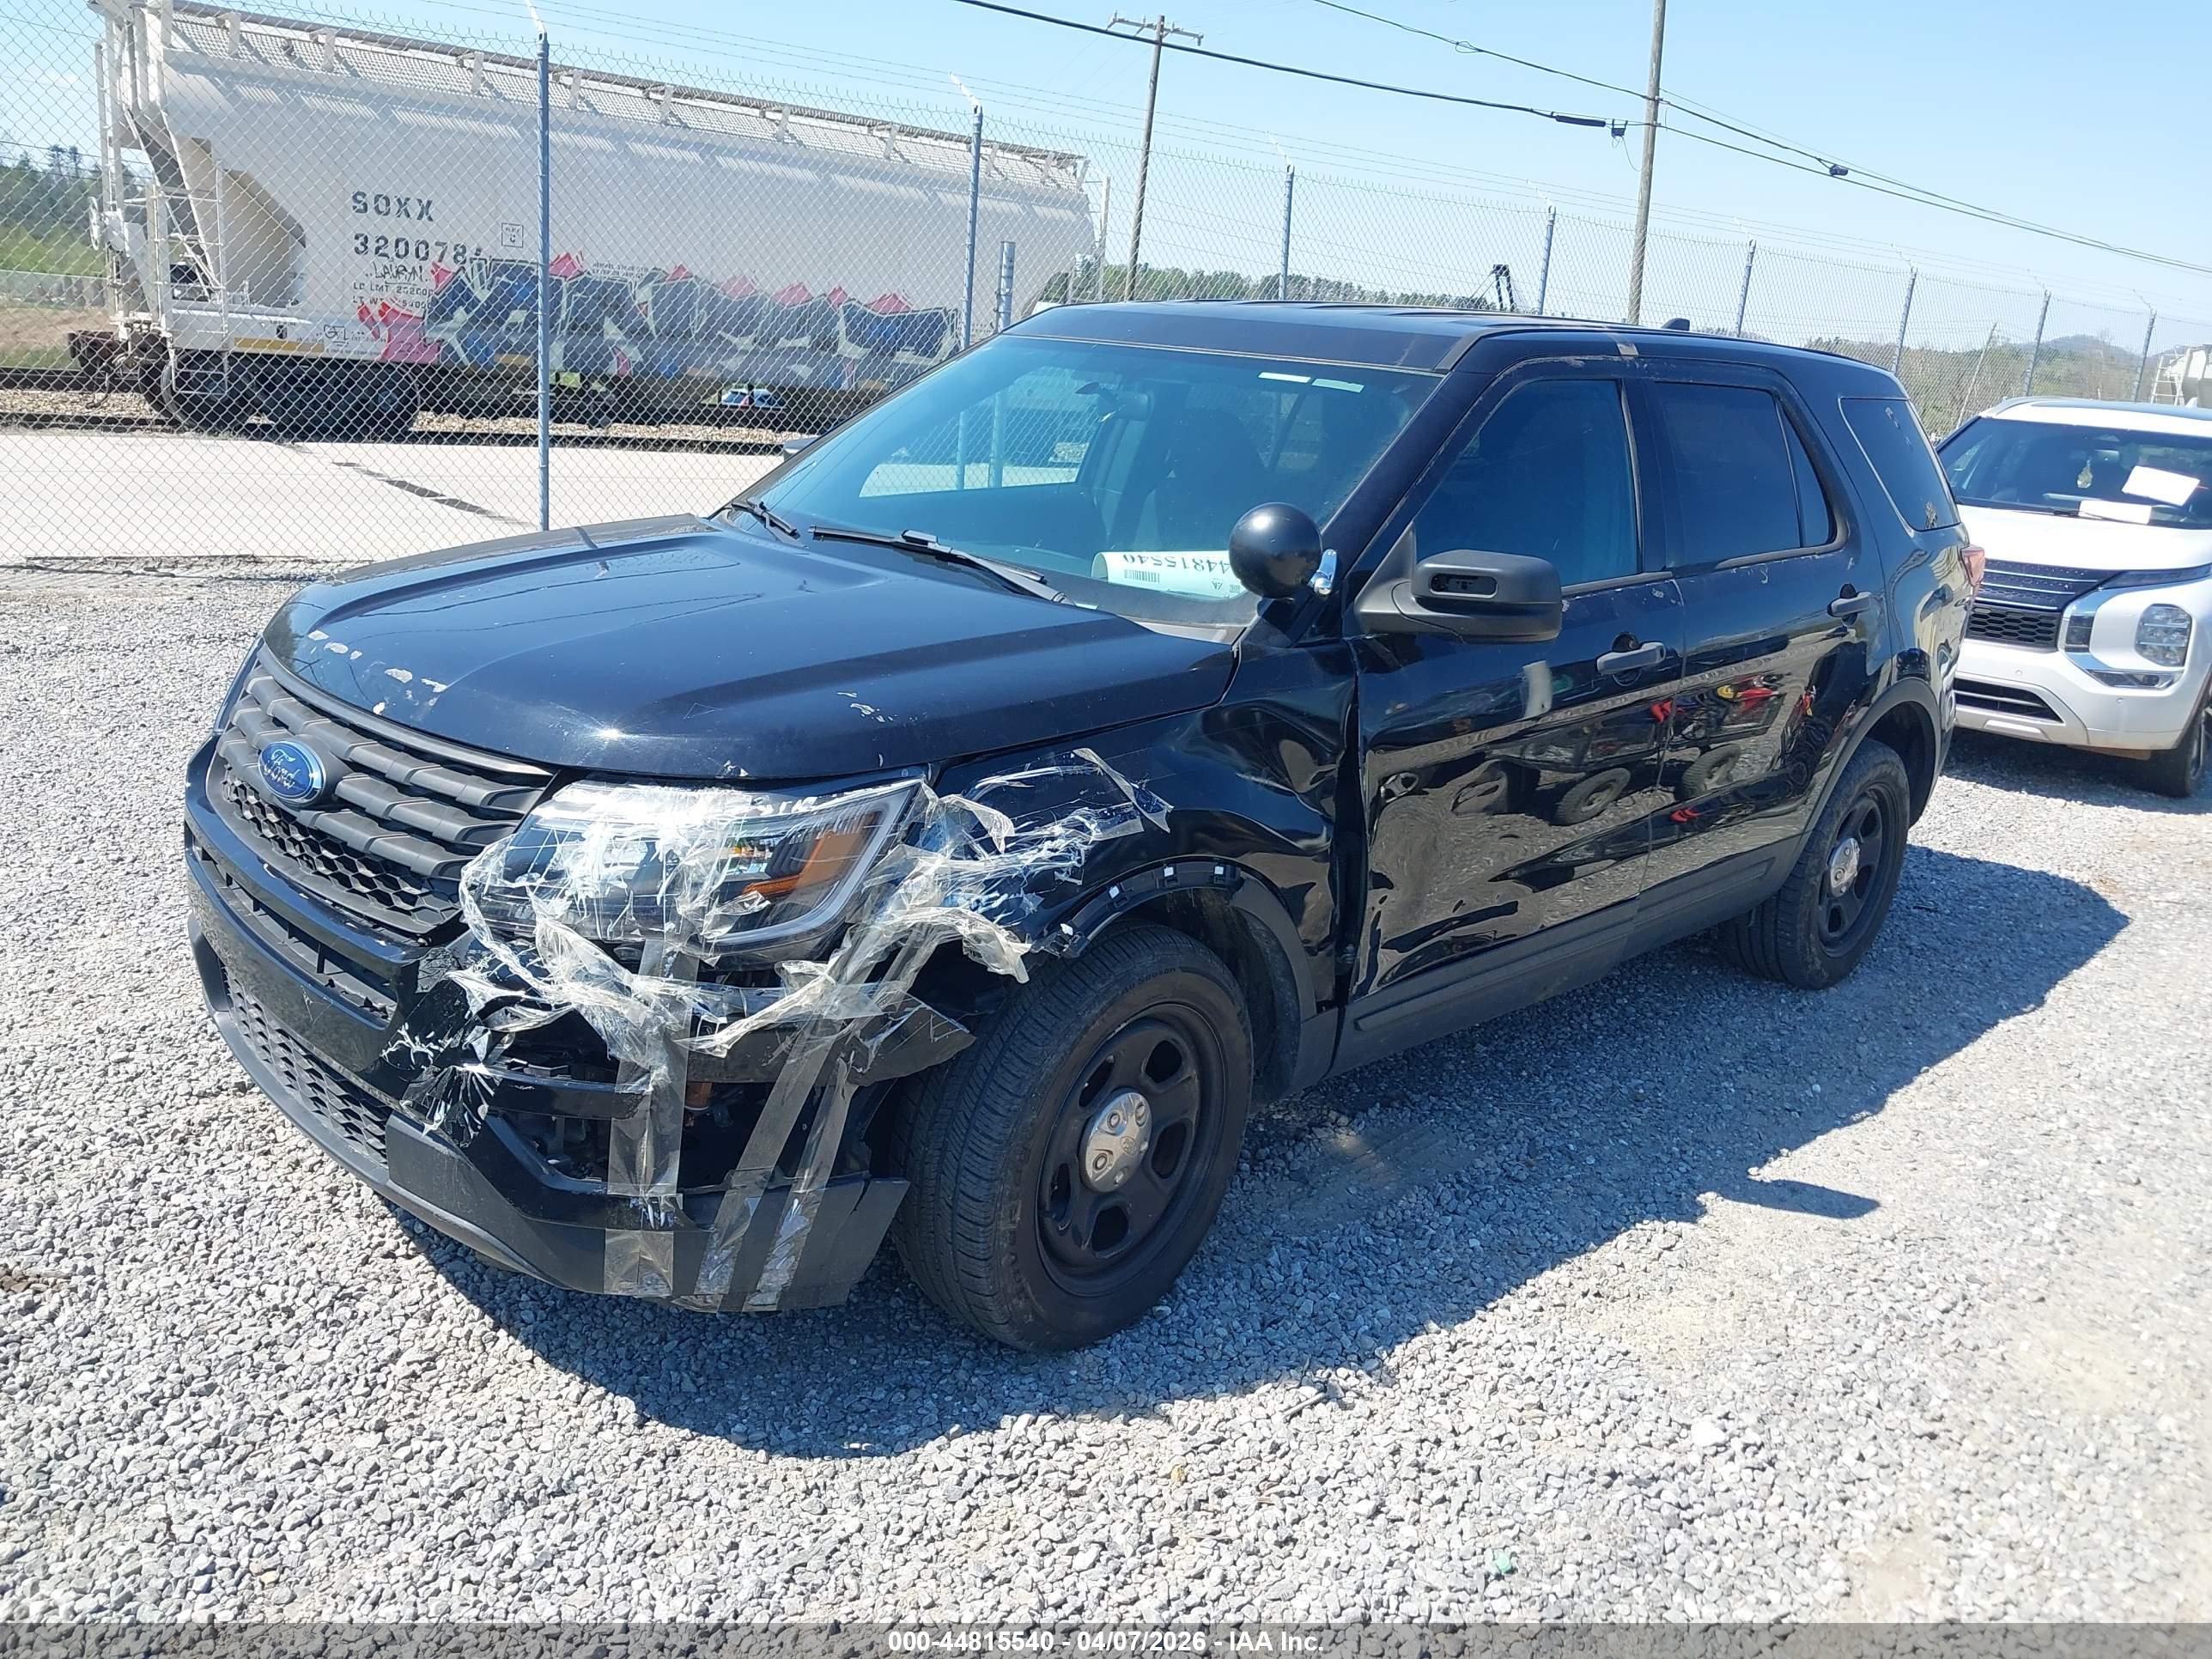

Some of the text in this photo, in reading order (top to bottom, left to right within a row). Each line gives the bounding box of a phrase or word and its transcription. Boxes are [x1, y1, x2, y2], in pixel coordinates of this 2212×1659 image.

[351, 190, 434, 222] SOXX
[353, 233, 467, 264] 320078
[1122, 554, 1230, 574] 44815540
[264, 749, 301, 789] Ford
